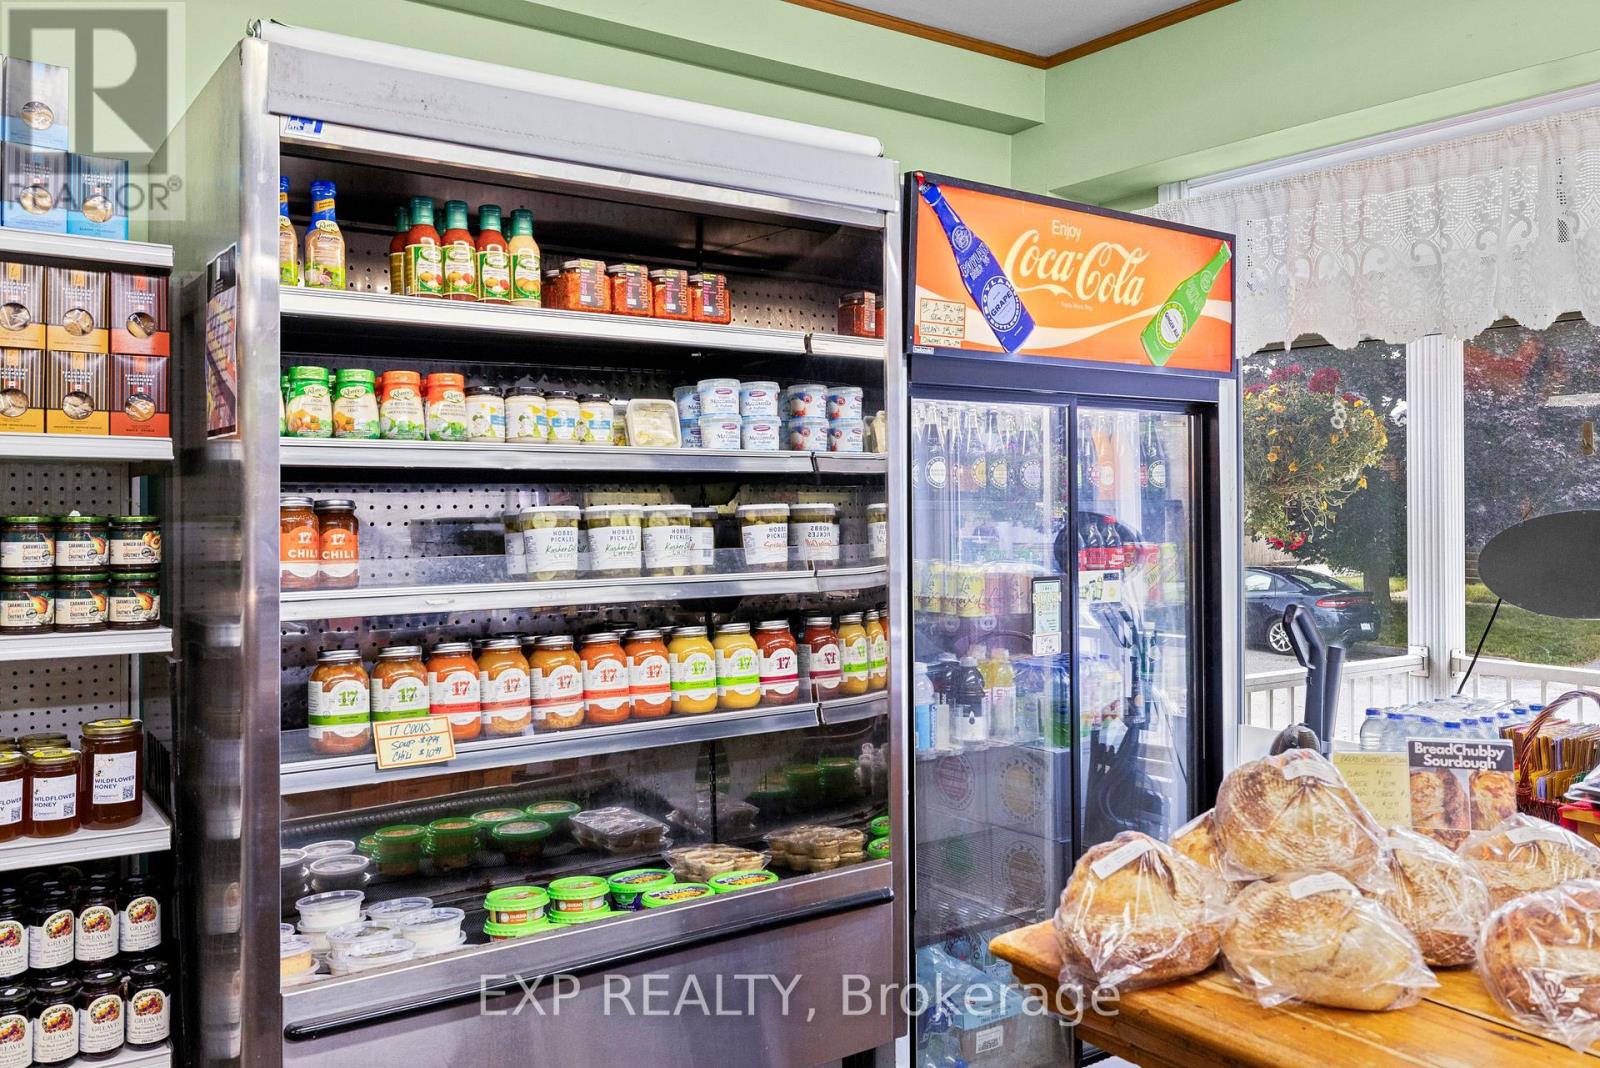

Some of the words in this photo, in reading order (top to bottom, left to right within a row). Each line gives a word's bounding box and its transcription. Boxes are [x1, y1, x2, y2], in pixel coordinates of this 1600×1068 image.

[1051, 219, 1083, 243] Enjoy
[1003, 228, 1150, 307] Coca-Cola
[715, 273, 727, 317] wildbrine
[990, 290, 1013, 317] GRAPE
[298, 531, 312, 544] 17
[330, 533, 346, 545] 17
[321, 550, 354, 559] CHILI
[646, 663, 663, 679] 17
[691, 659, 707, 675] 17
[736, 655, 753, 671] 17
[776, 656, 791, 670] 17
[558, 674, 573, 690] 17
[600, 666, 618, 683] 17
[451, 680, 471, 696] 17
[504, 677, 521, 694] 17
[338, 690, 359, 707] 17
[398, 686, 418, 703] 17
[389, 724, 400, 737] 17
[403, 722, 431, 736] COOKS
[391, 739, 416, 751] SOUP
[1414, 741, 1506, 761] BreadChubby
[1423, 754, 1497, 771] Sourdough
[94, 774, 135, 784] WILDFLOWER
